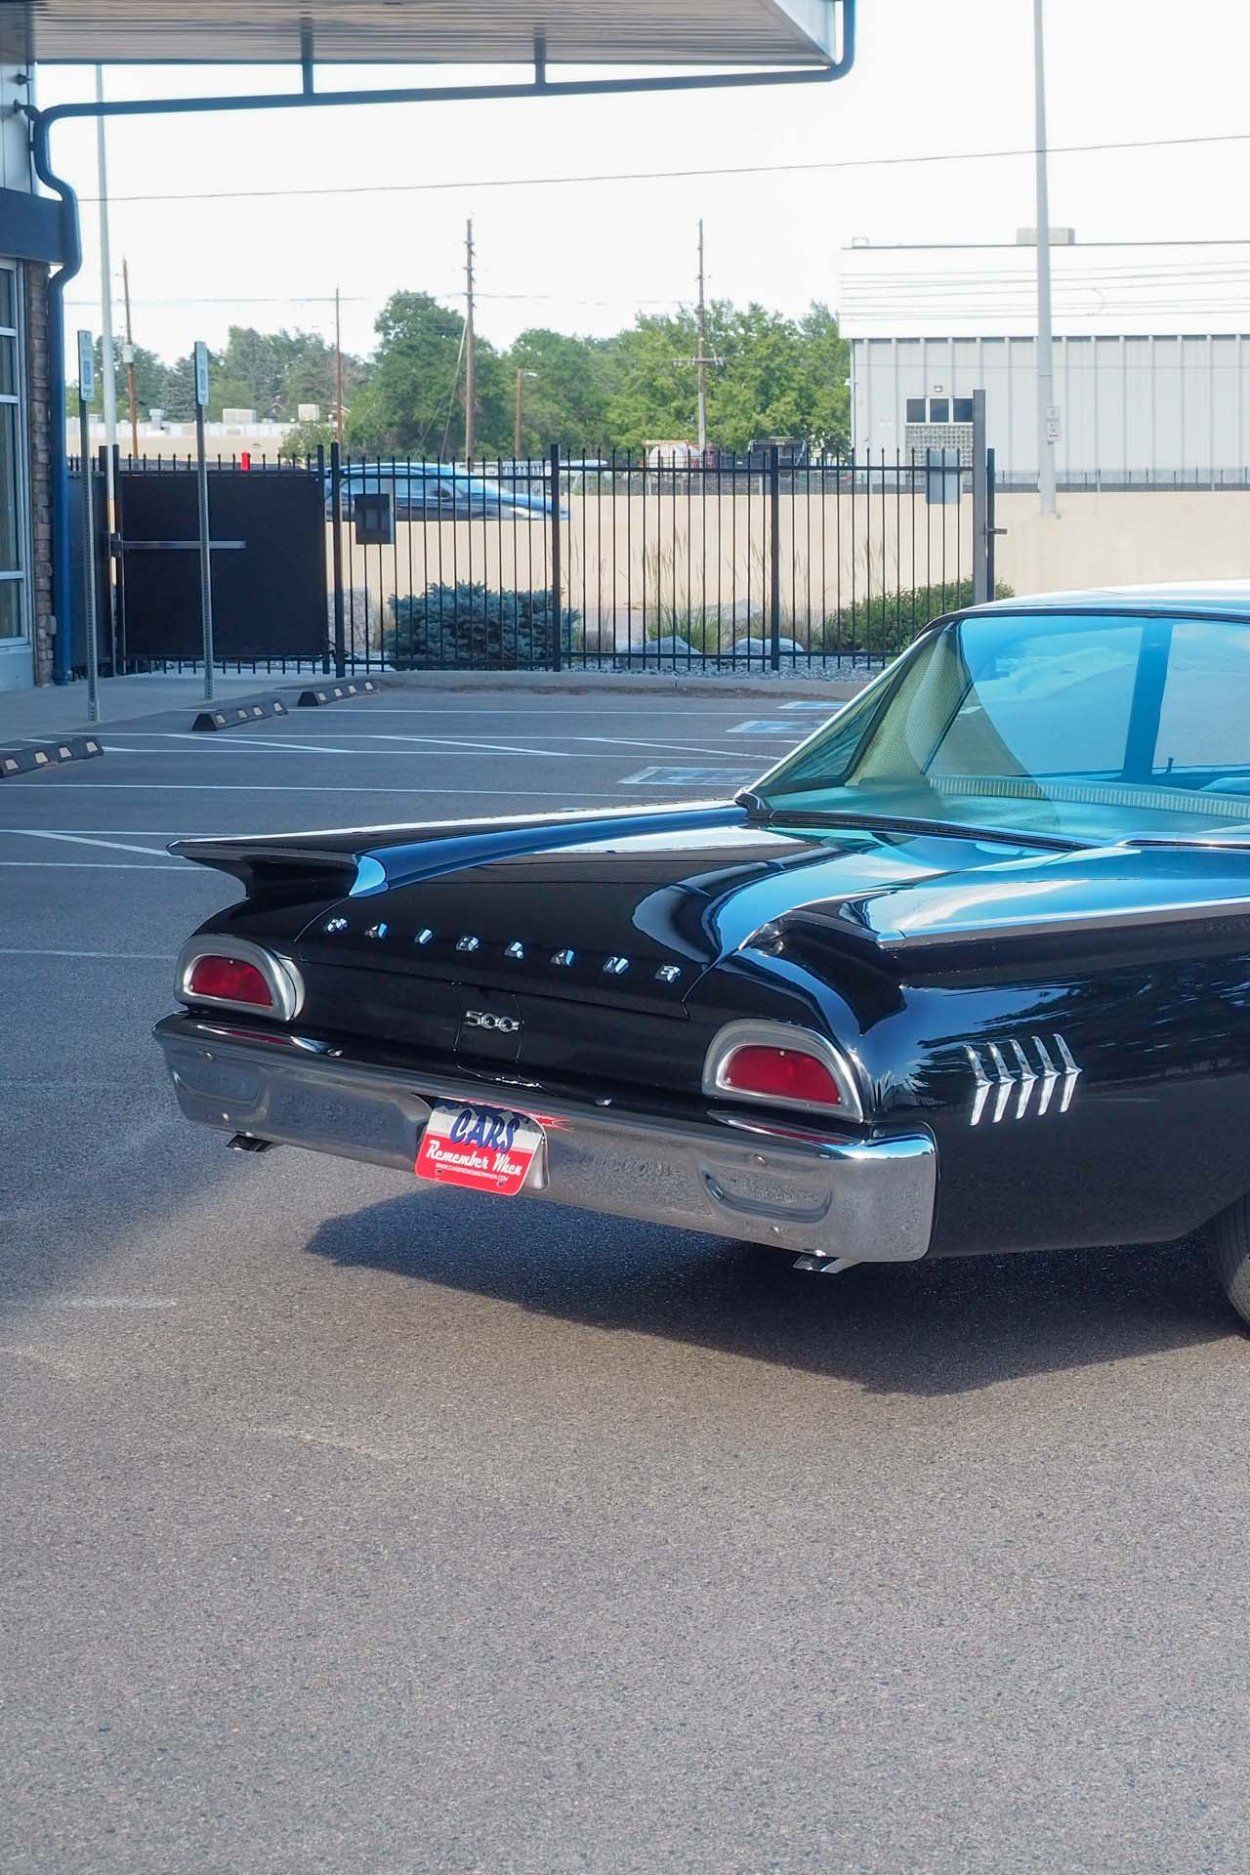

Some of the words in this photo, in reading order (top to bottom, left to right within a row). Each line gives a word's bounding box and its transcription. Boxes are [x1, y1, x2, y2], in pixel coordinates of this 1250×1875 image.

[465, 1010, 520, 1033] 500
[449, 1108, 520, 1153] CARS
[426, 1139, 490, 1170] Remember
[492, 1151, 523, 1177] When
